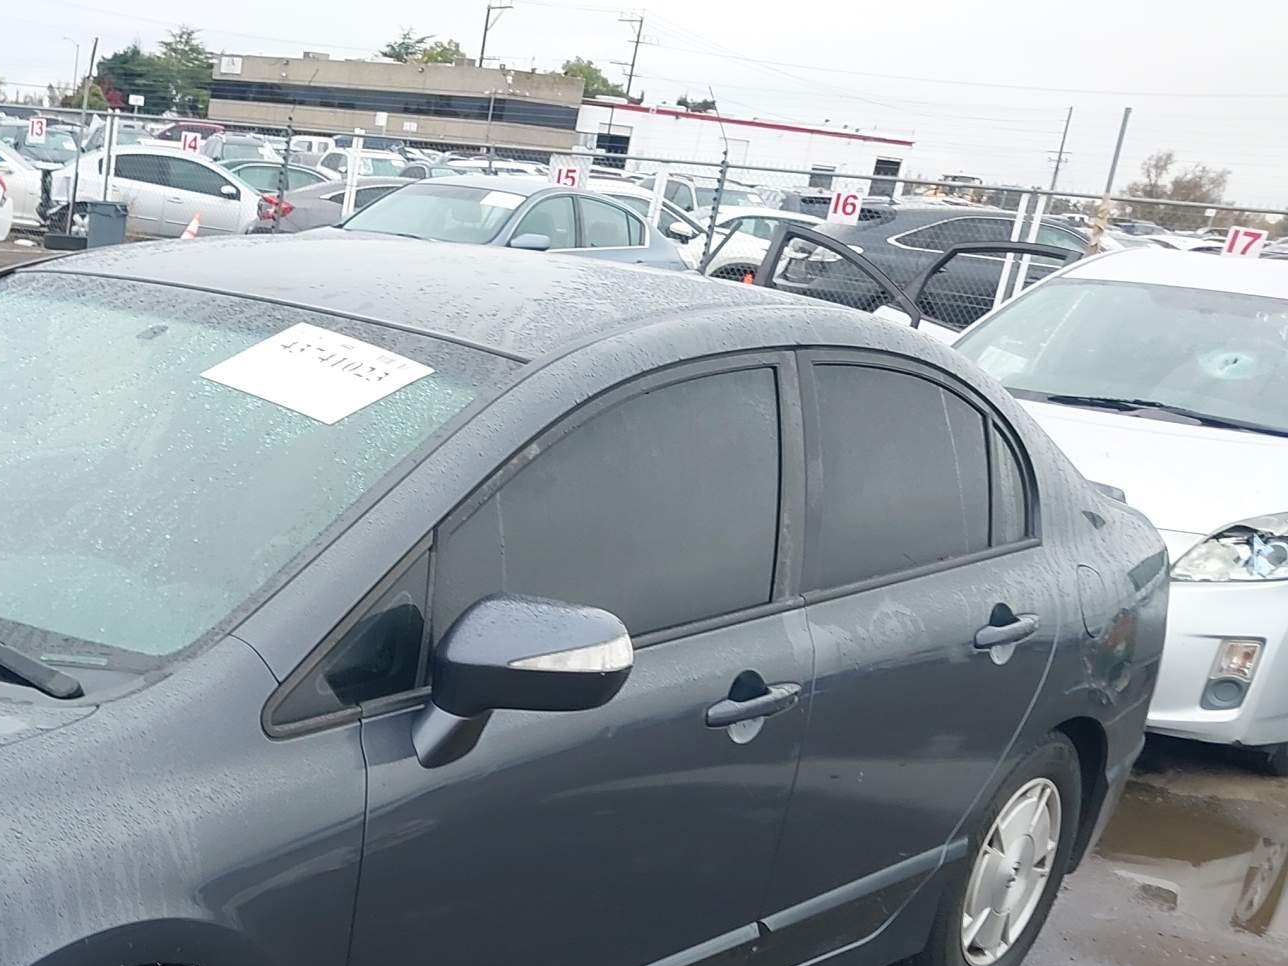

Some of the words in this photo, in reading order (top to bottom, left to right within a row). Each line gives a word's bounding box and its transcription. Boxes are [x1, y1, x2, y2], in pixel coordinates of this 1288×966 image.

[30, 120, 44, 137] 13
[182, 133, 198, 153] 14
[555, 168, 577, 187] 15
[832, 192, 859, 216] 16
[1226, 229, 1263, 256] 17
